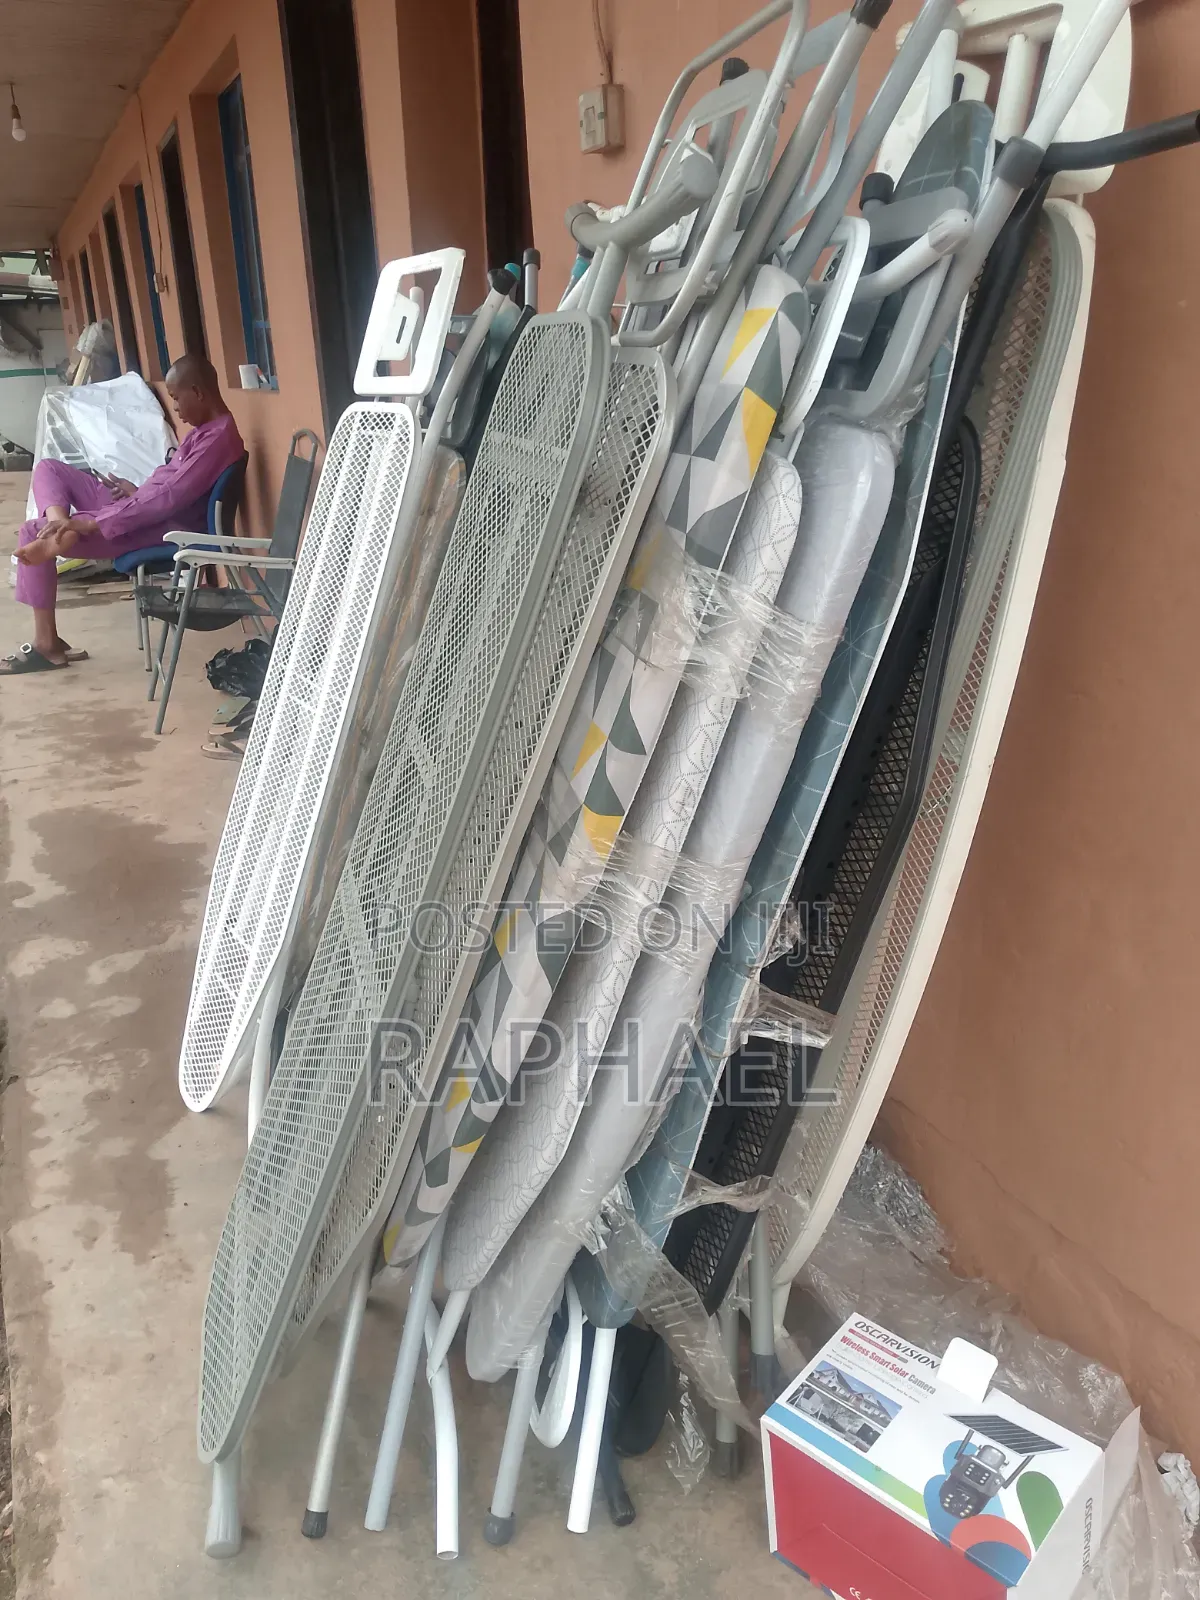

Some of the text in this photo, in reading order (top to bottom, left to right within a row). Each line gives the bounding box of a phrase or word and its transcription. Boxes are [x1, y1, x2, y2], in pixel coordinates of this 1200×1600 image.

[840, 1335, 870, 1357] Wireless
[868, 1351, 891, 1369] Smart
[889, 1363, 910, 1379] Solar
[908, 1374, 937, 1396] Camera
[854, 1321, 941, 1370] OSCARVISION
